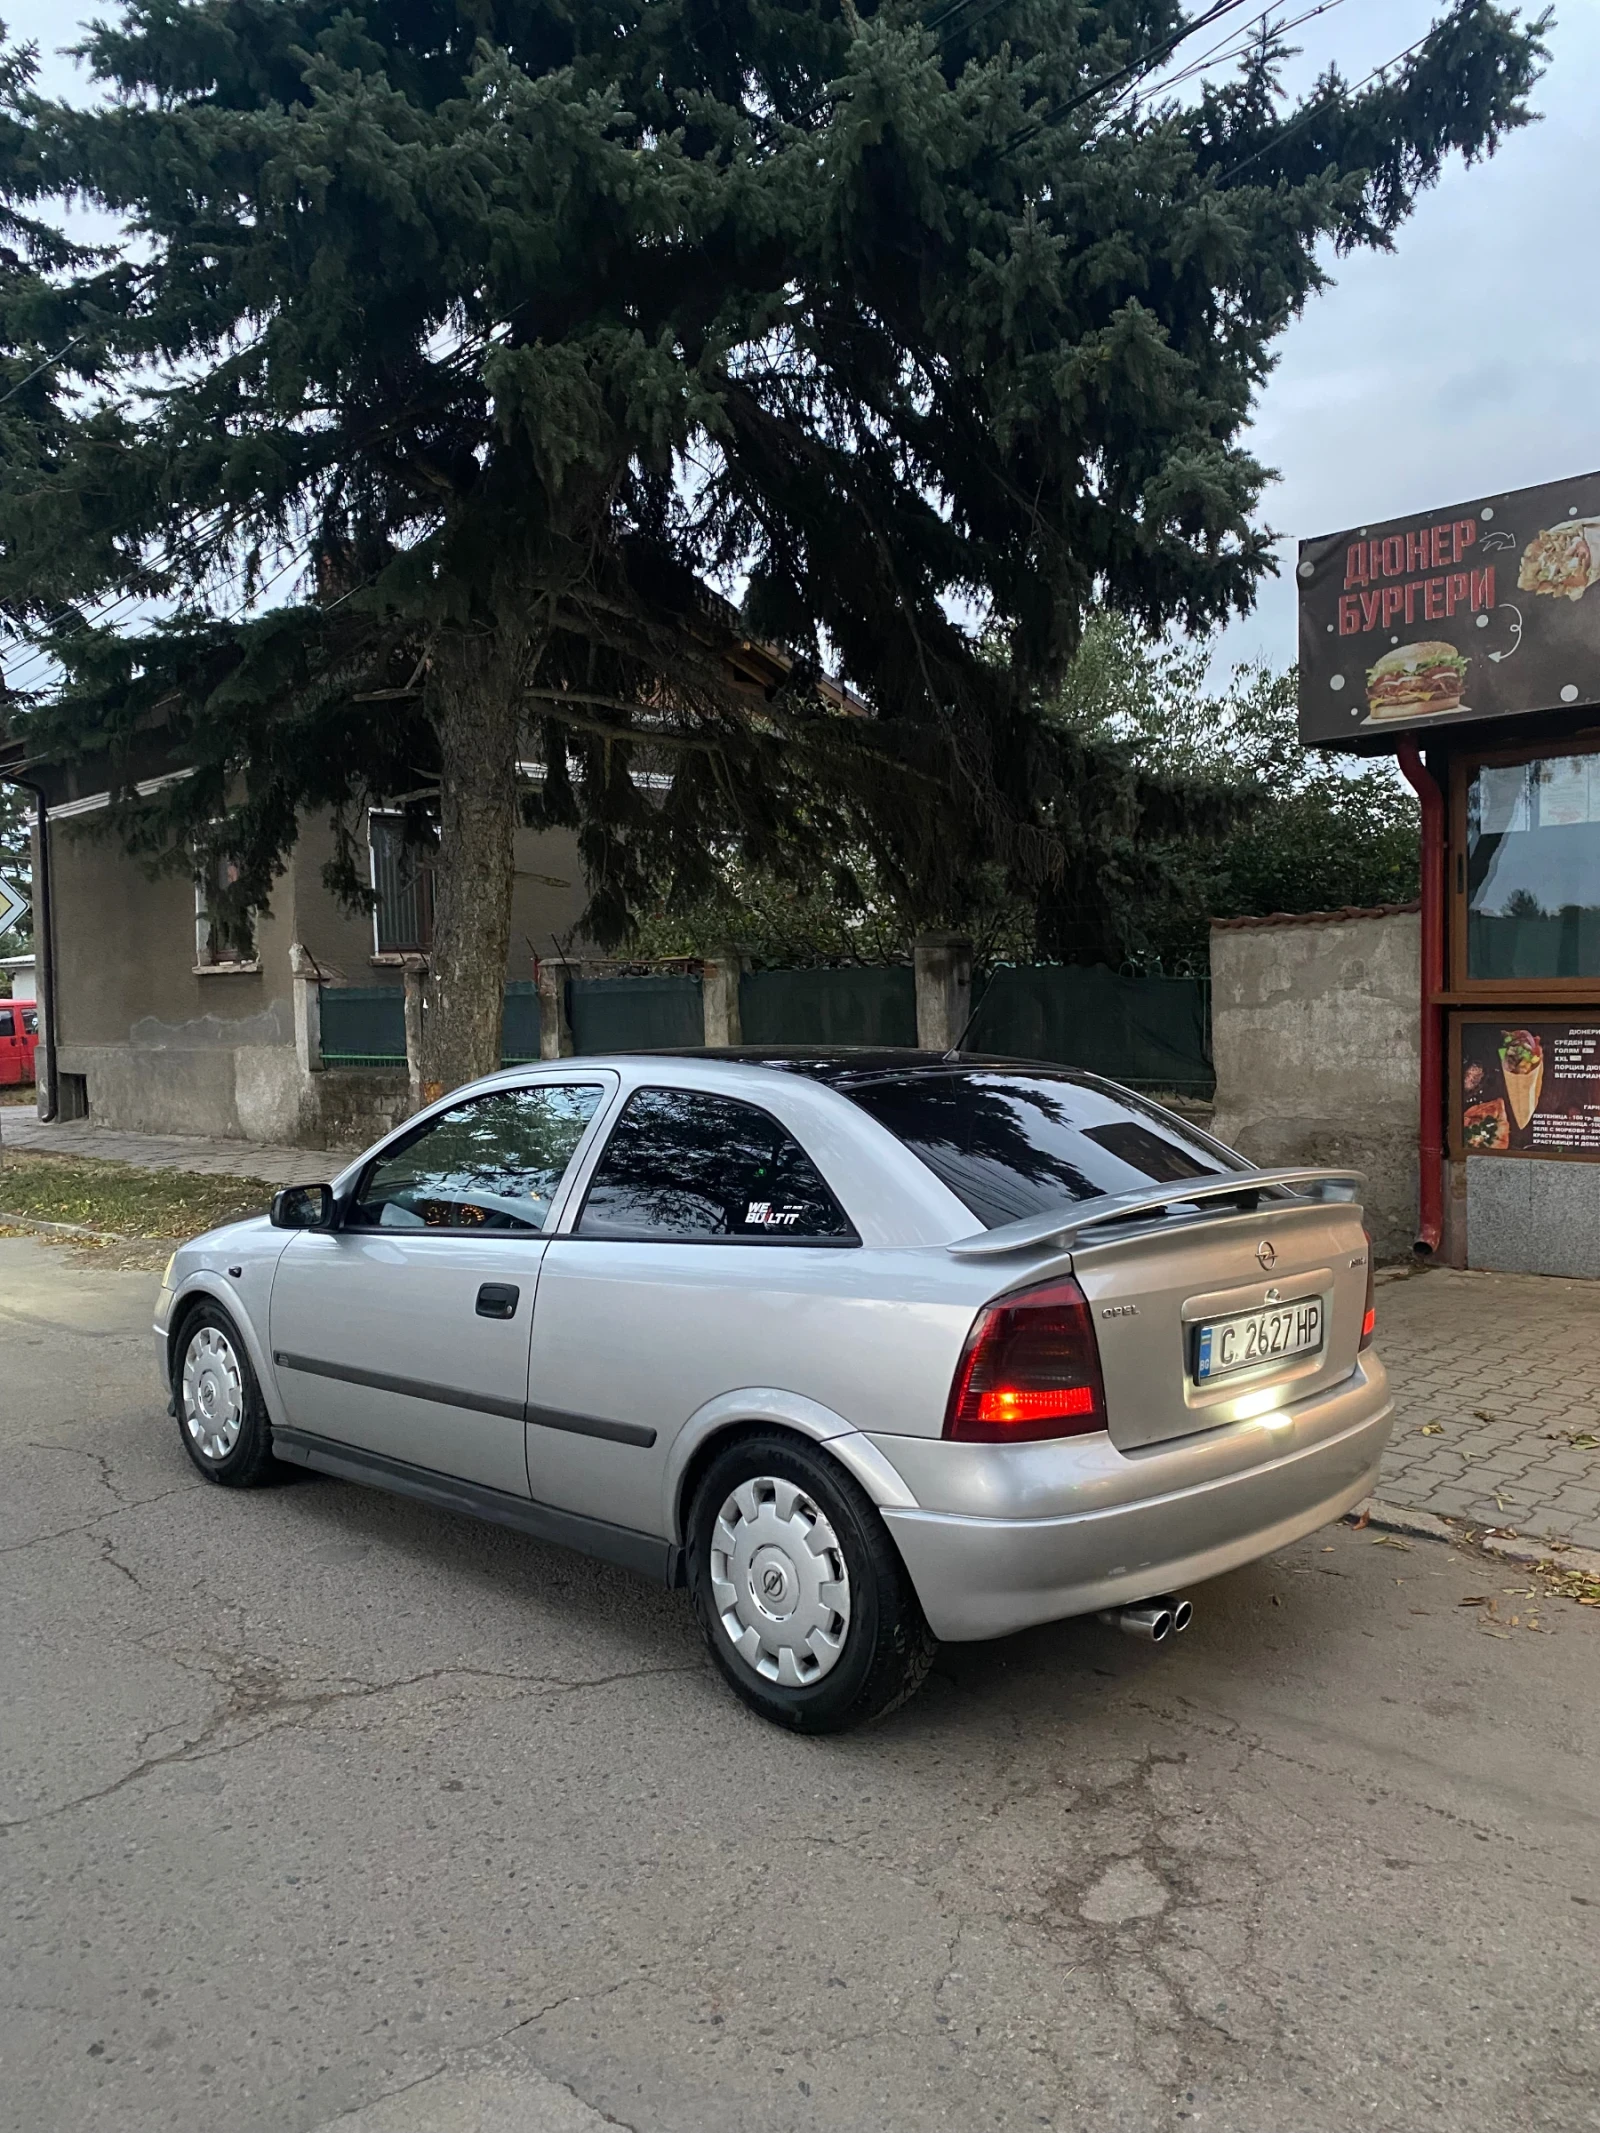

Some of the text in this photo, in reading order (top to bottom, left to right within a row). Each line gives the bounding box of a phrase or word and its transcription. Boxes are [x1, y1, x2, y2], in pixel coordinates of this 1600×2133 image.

[1343, 518, 1476, 590] ДЮНЕР
[1338, 565, 1496, 636] БУРГЕРИ
[747, 1202, 771, 1213] WE
[783, 1213, 799, 1225] IT
[1102, 1305, 1140, 1319] OPEL
[1220, 1306, 1319, 1366] C 2627 HP
[1200, 1358, 1210, 1372] BG
